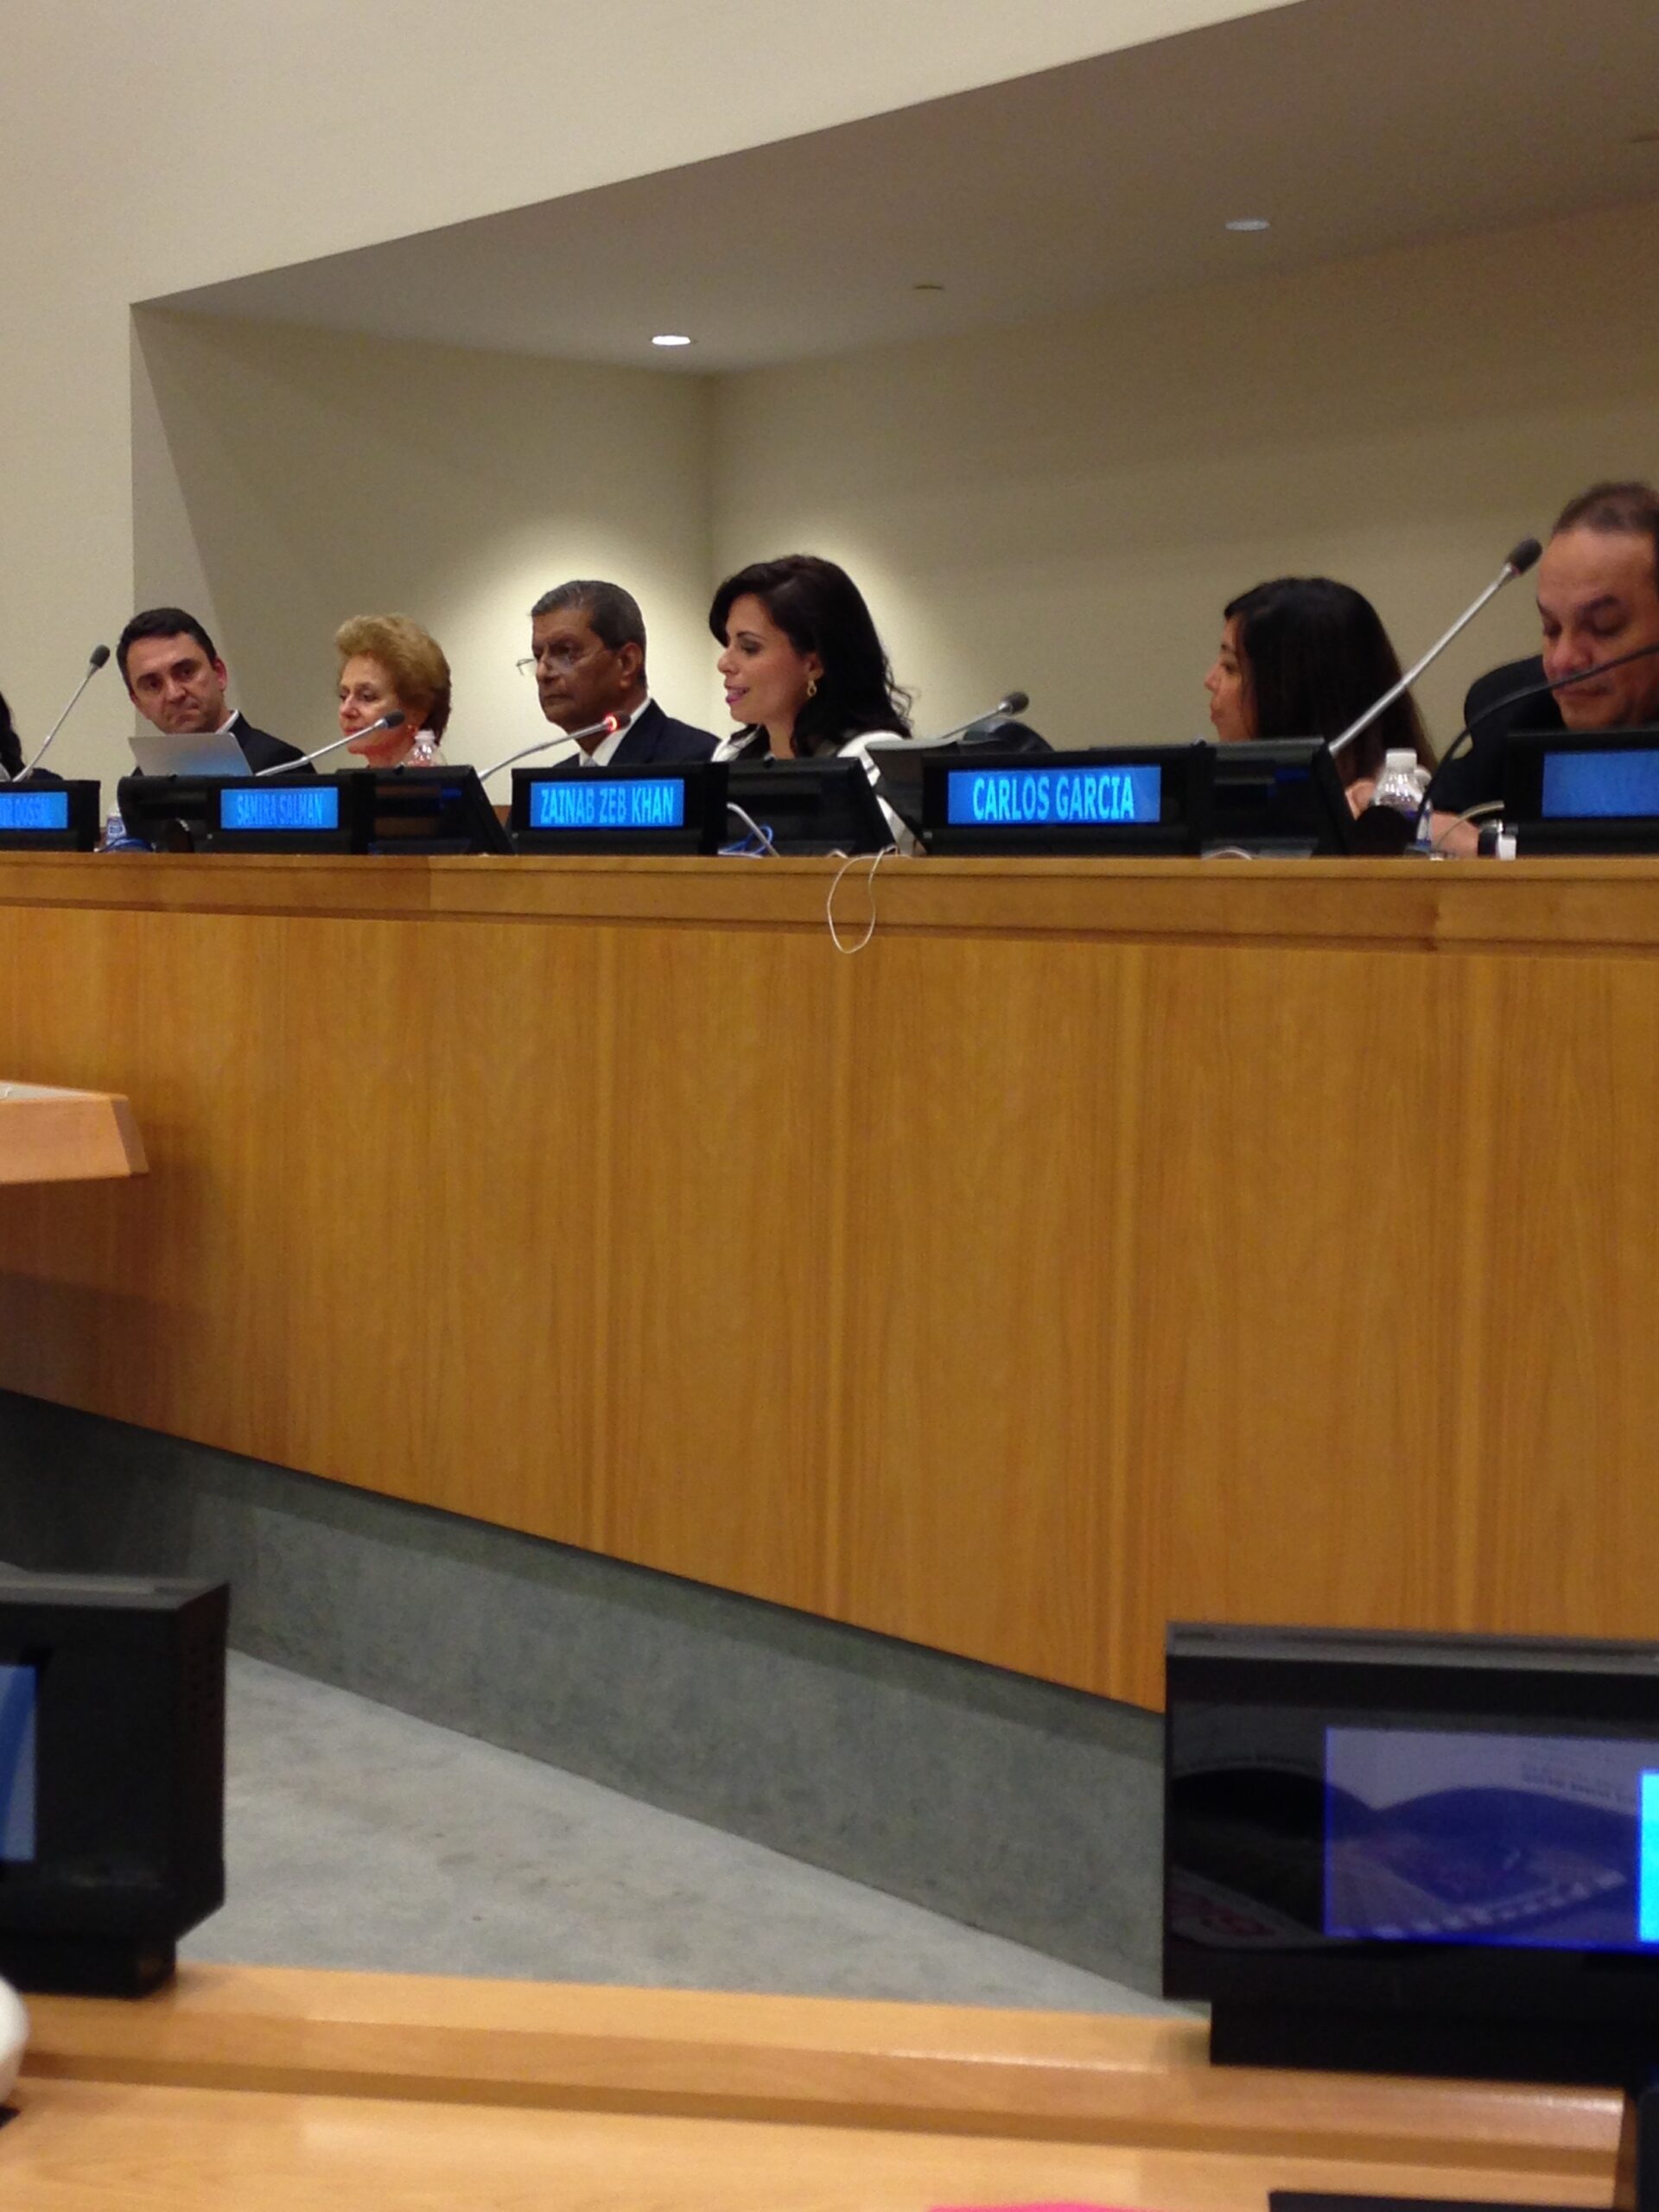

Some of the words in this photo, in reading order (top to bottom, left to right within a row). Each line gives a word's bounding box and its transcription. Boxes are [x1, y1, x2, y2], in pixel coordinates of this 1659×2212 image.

[237, 794, 277, 825] SAMIRA
[540, 788, 594, 824] ZAINAB
[600, 788, 626, 824] ZEB
[632, 786, 674, 823] KHAN
[973, 776, 1050, 821] CARLOS
[1056, 774, 1135, 820] GARCIA
